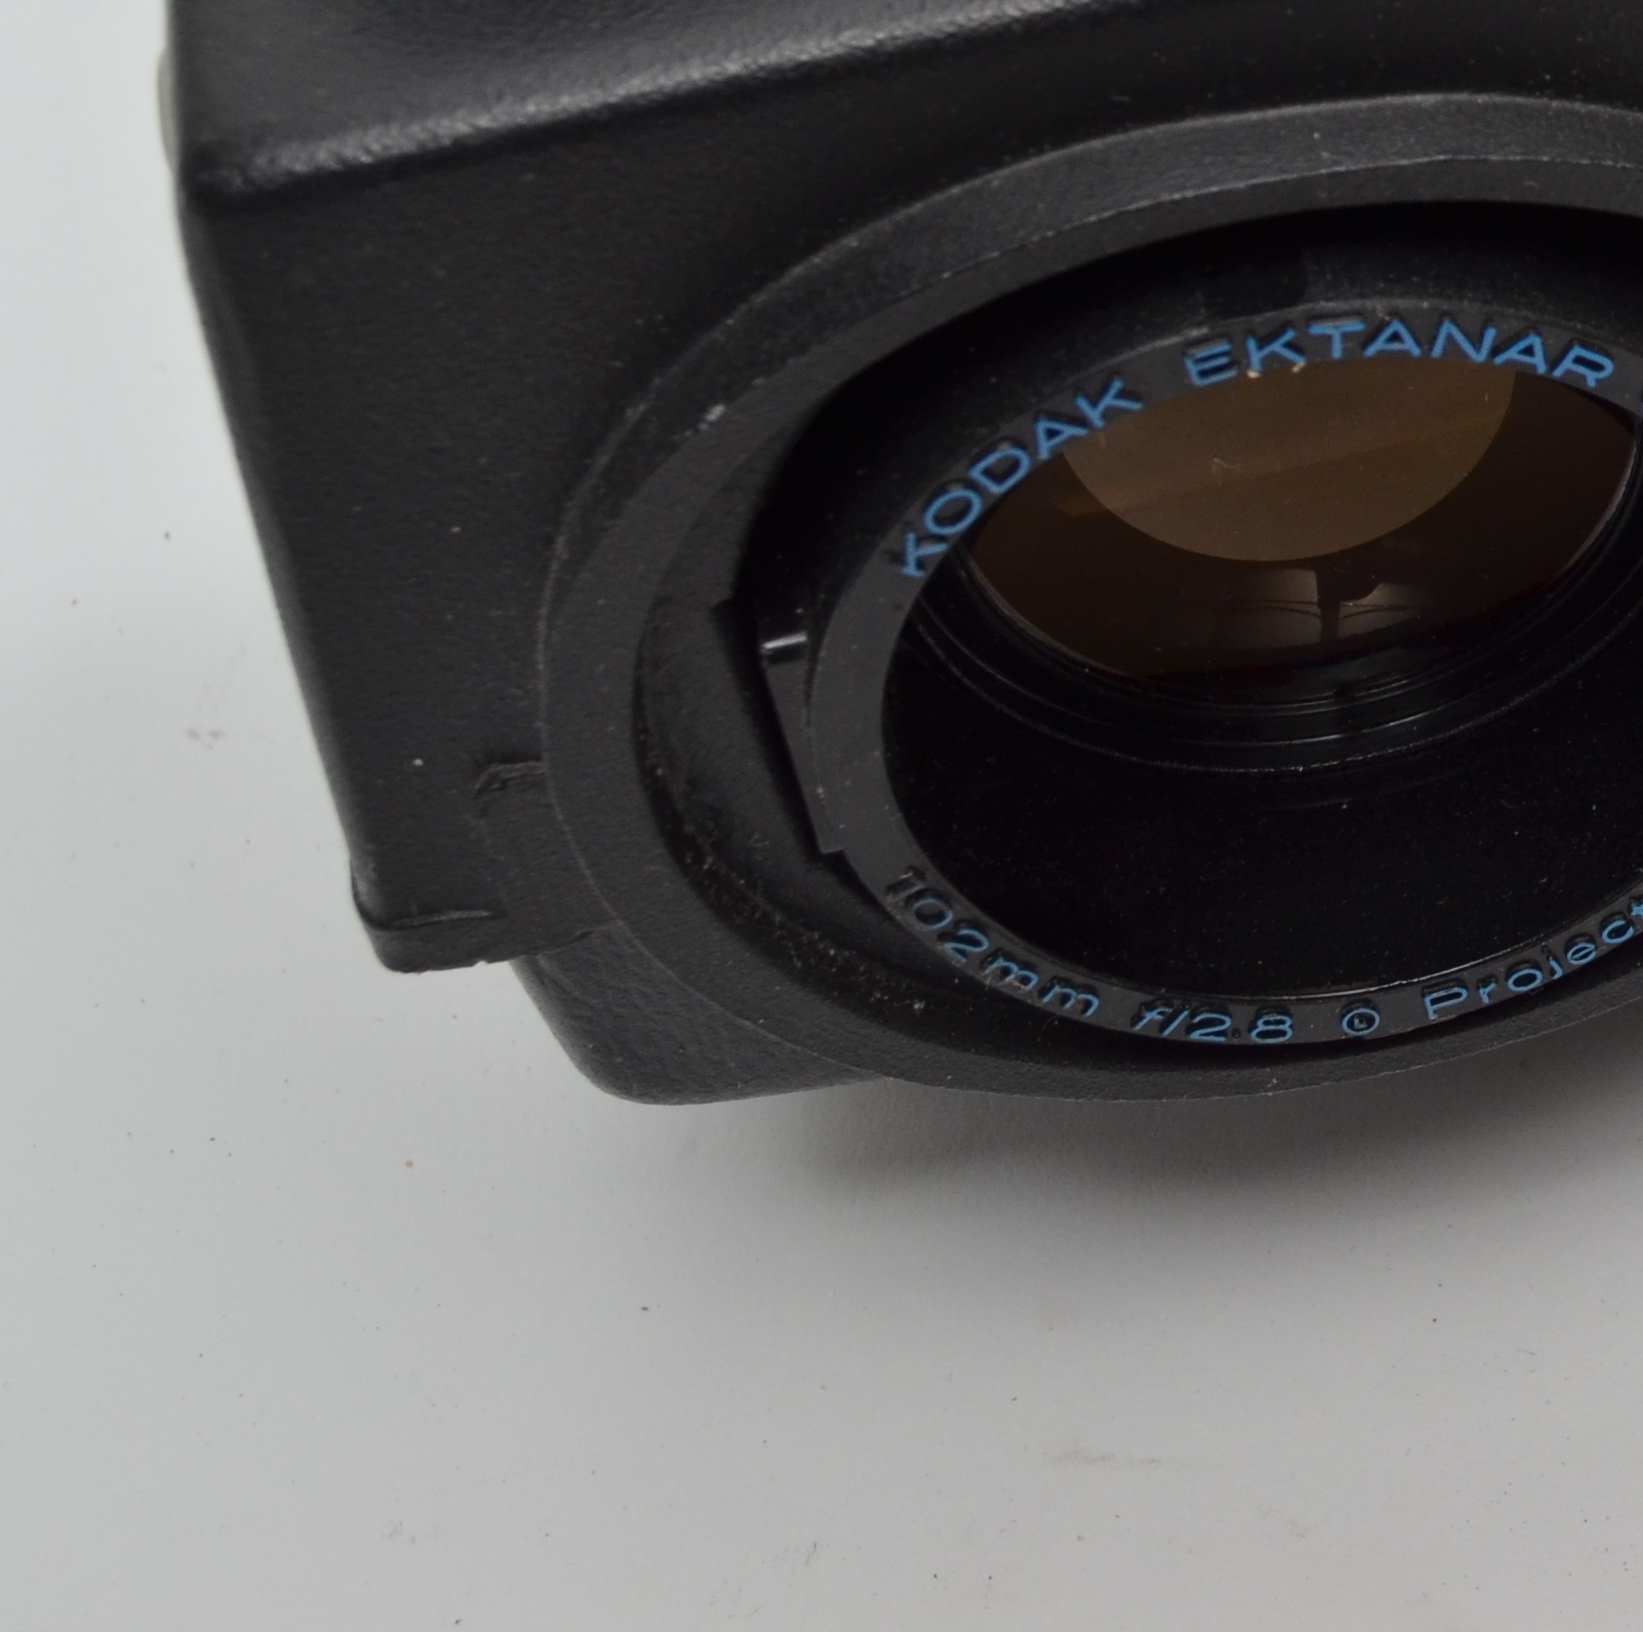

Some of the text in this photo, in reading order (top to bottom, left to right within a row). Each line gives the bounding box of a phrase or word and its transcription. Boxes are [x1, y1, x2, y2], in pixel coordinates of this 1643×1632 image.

[902, 378, 1142, 578] KODAK
[1183, 319, 1617, 389] EKTANAR
[886, 870, 1101, 1018] 102mm
